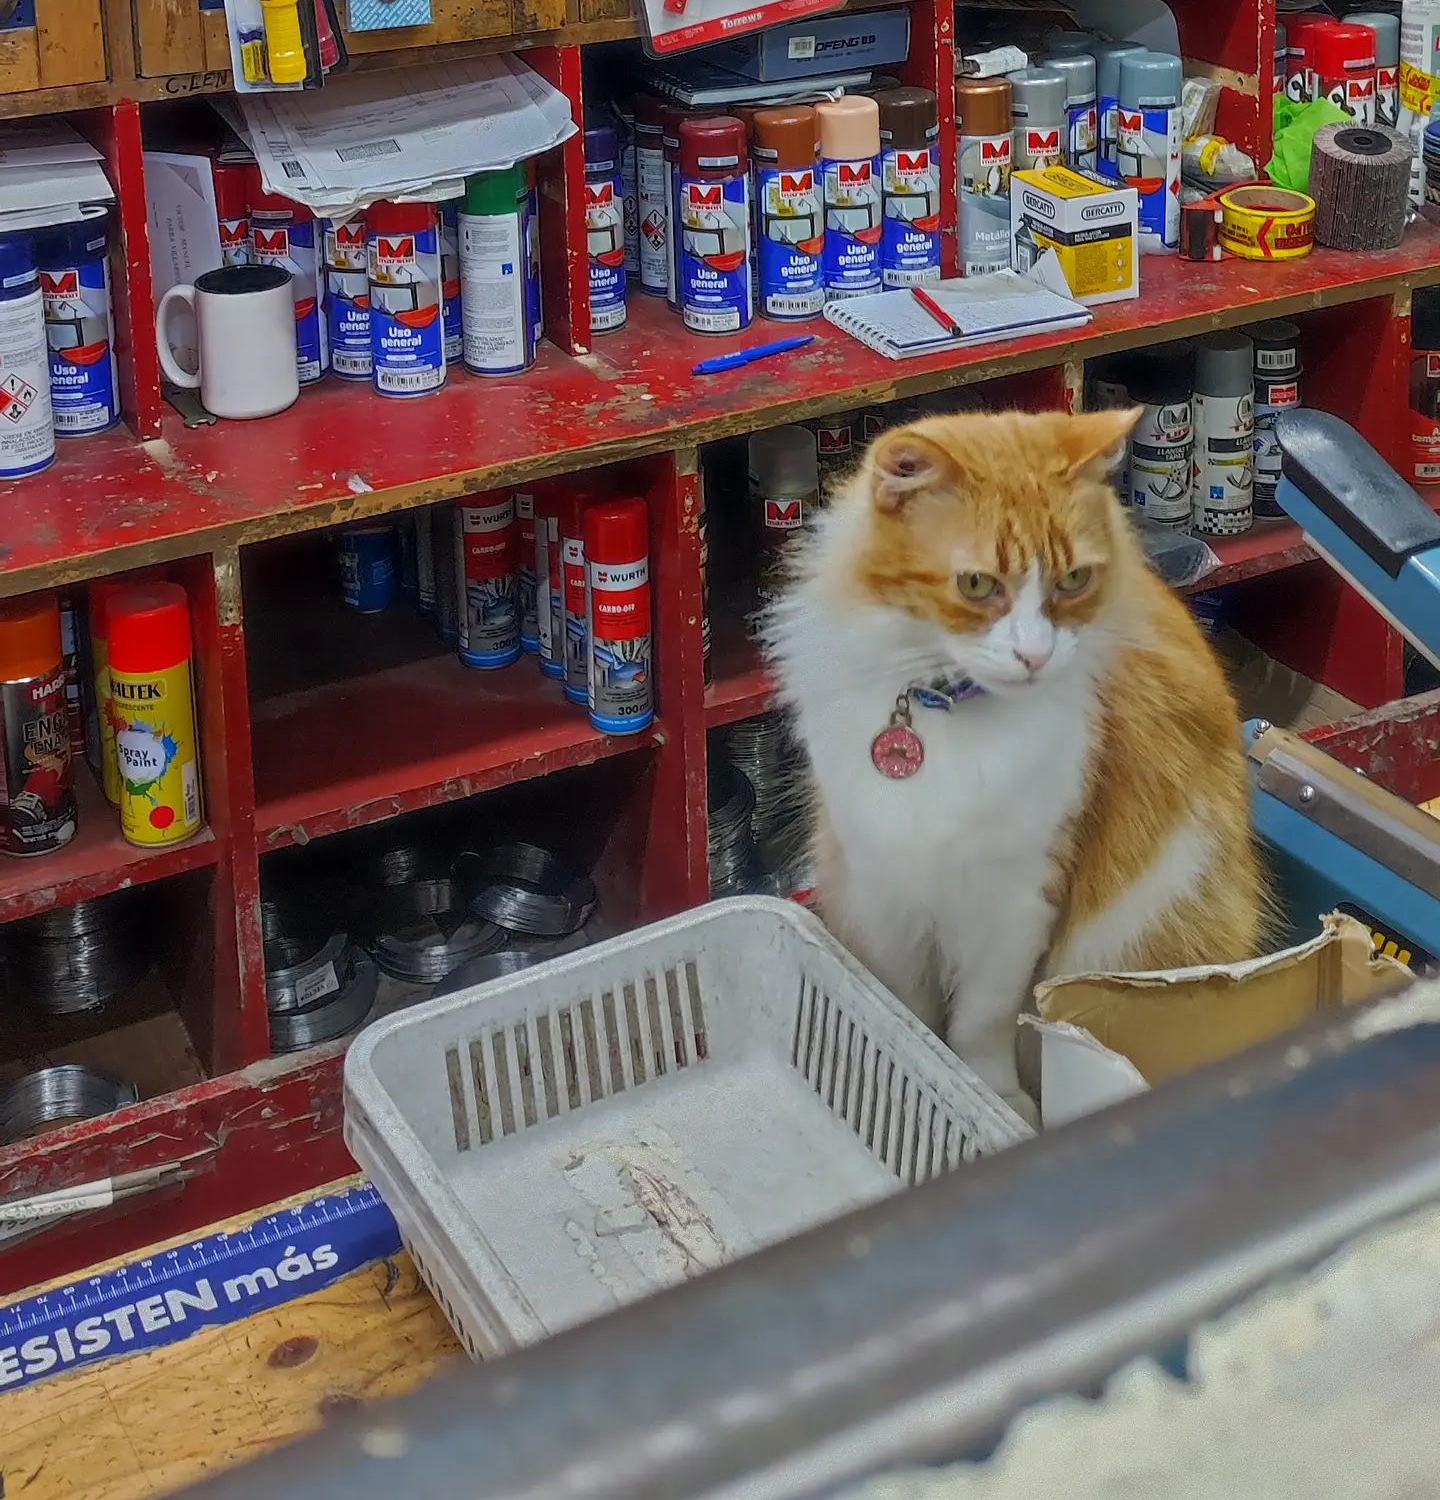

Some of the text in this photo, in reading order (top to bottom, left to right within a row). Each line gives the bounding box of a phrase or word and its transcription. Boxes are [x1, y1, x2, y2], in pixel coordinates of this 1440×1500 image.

[720, 10, 763, 30] Torrews
[1024, 192, 1053, 217] BERCATTI
[1085, 205, 1122, 218] BERCATTI
[905, 233, 926, 242] Uso
[847, 245, 867, 255] Uso
[897, 240, 933, 253] general
[790, 255, 811, 265] Uso
[838, 252, 875, 265] general
[591, 268, 611, 279] Uso
[697, 269, 718, 280] Uso
[781, 263, 818, 277] general
[589, 275, 618, 287] eneral
[690, 277, 728, 290] general
[347, 311, 370, 322] Uso
[339, 321, 370, 332] gener
[388, 327, 412, 338] Uso
[381, 334, 422, 348] general
[54, 364, 77, 376] Uso
[599, 603, 635, 614] CARBO-OFF
[618, 705, 639, 716] 300
[24, 713, 64, 743] ENG
[33, 734, 61, 755] ENA
[119, 744, 148, 761] Spray
[126, 755, 158, 767] Paint
[223, 1243, 340, 1303] más
